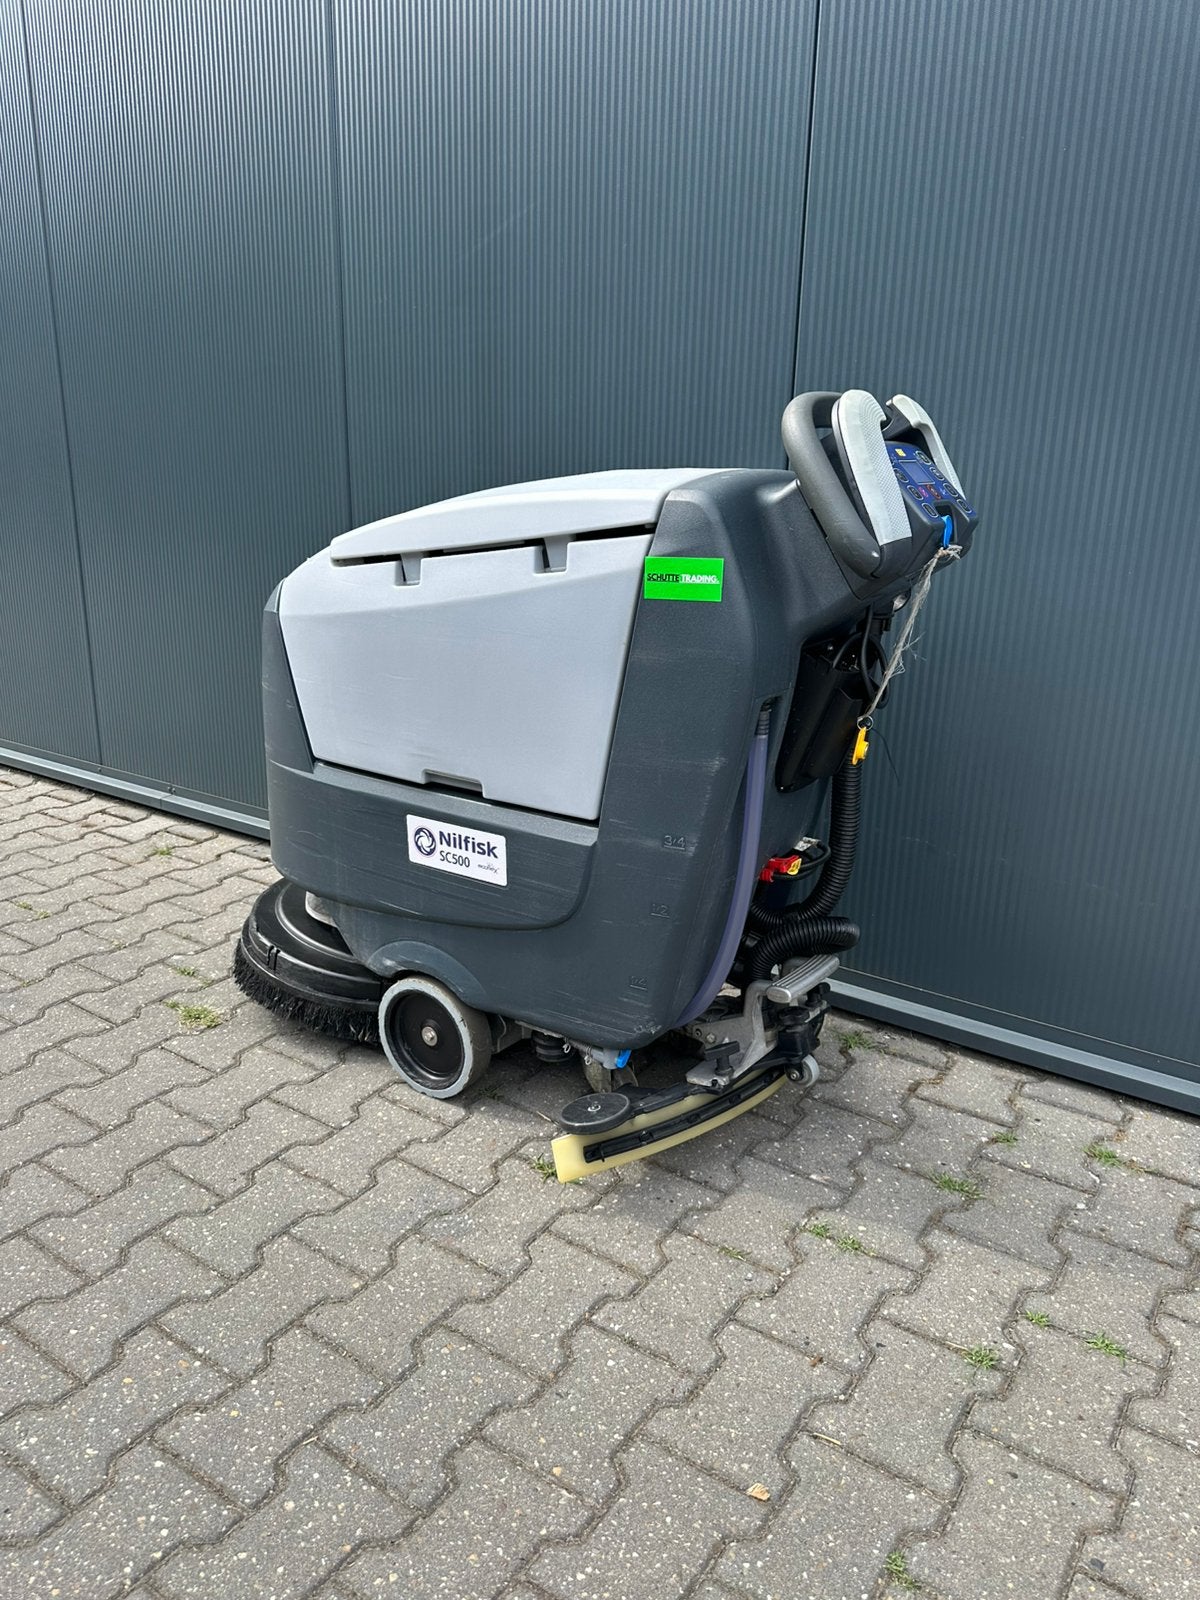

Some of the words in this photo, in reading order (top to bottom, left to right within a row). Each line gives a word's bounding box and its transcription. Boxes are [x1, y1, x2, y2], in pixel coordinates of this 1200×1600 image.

[647, 573, 680, 583] SCHUTTE
[439, 830, 498, 859] Nilfisk
[440, 850, 471, 868] SC500
